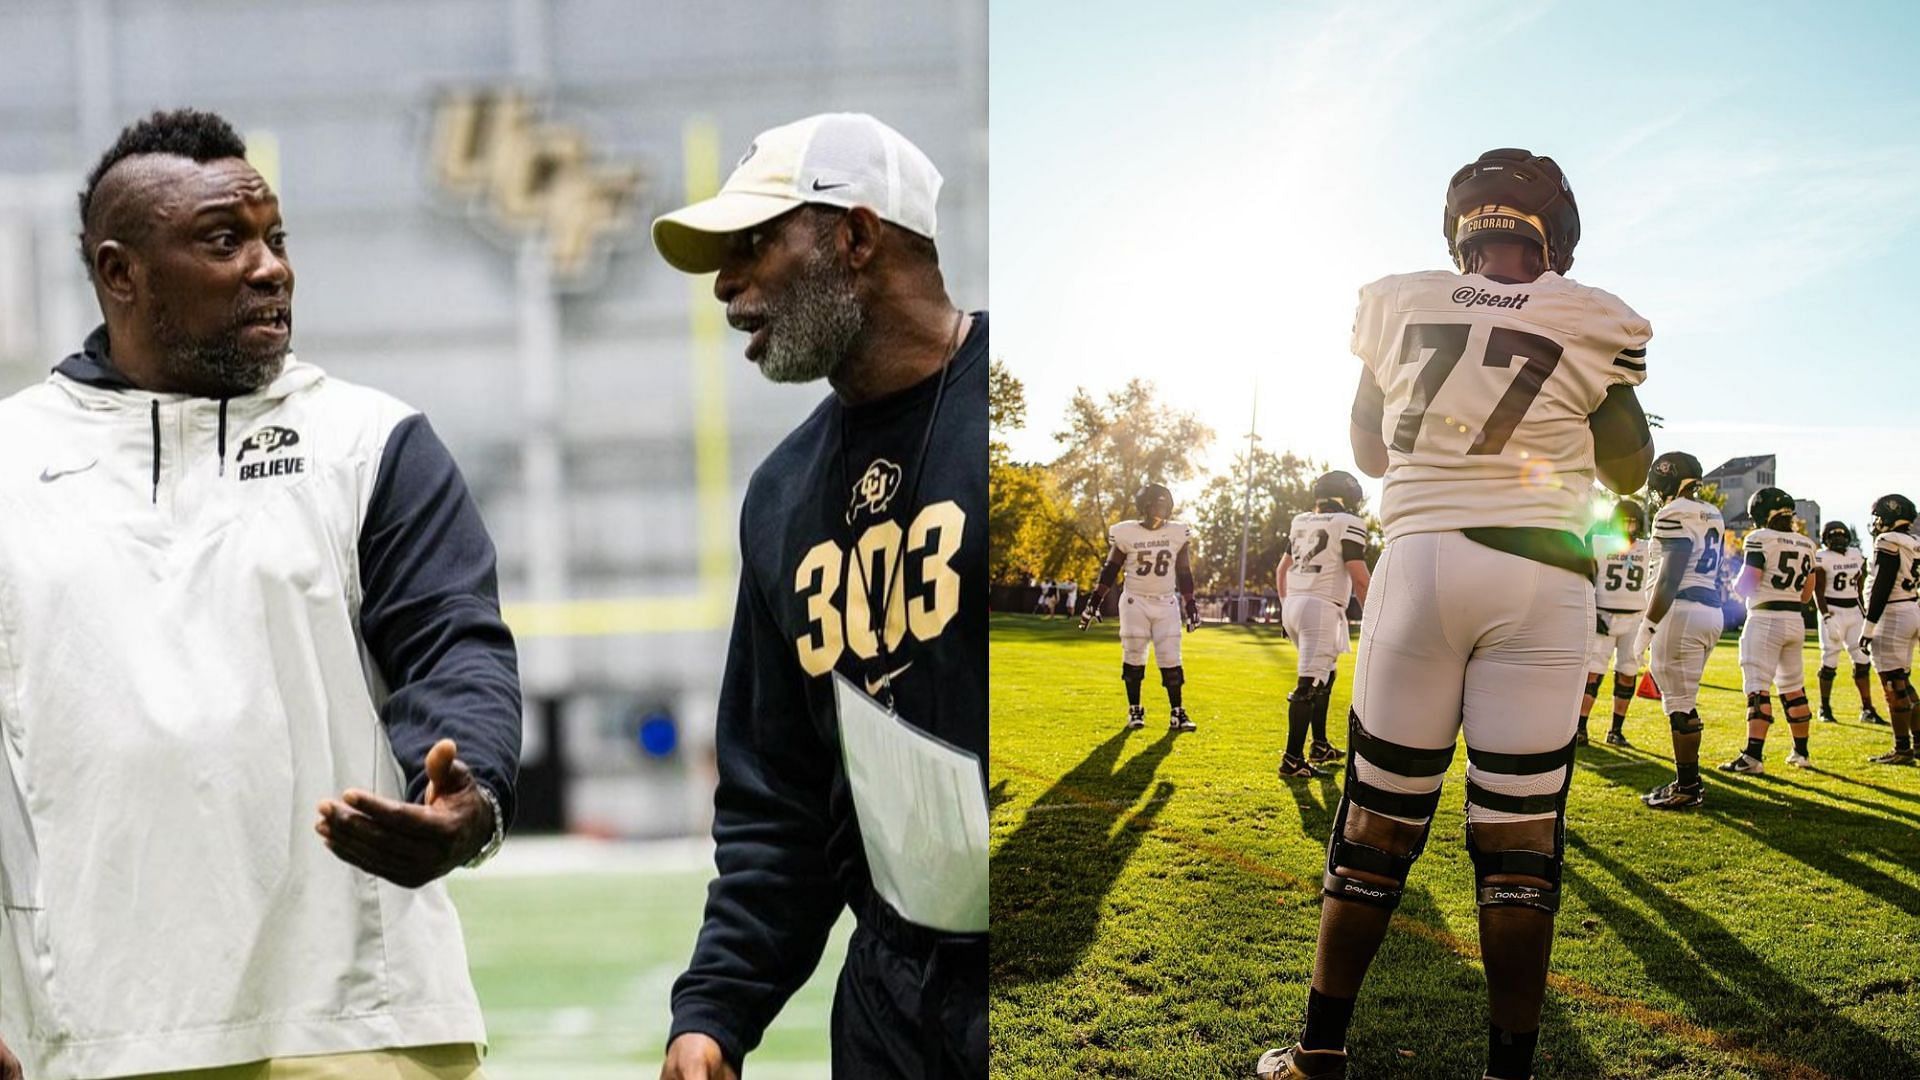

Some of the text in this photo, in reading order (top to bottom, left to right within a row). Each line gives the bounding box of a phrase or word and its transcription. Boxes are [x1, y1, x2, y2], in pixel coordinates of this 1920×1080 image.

[1467, 217, 1516, 233] COLORADO
[1451, 286, 1533, 310] @jseatt
[1389, 323, 1564, 456] 77
[239, 458, 305, 481] BELIEVE
[1135, 549, 1173, 577] 56
[794, 499, 967, 678] 303
[1604, 563, 1645, 592] 59
[1344, 884, 1385, 898] DONJOY
